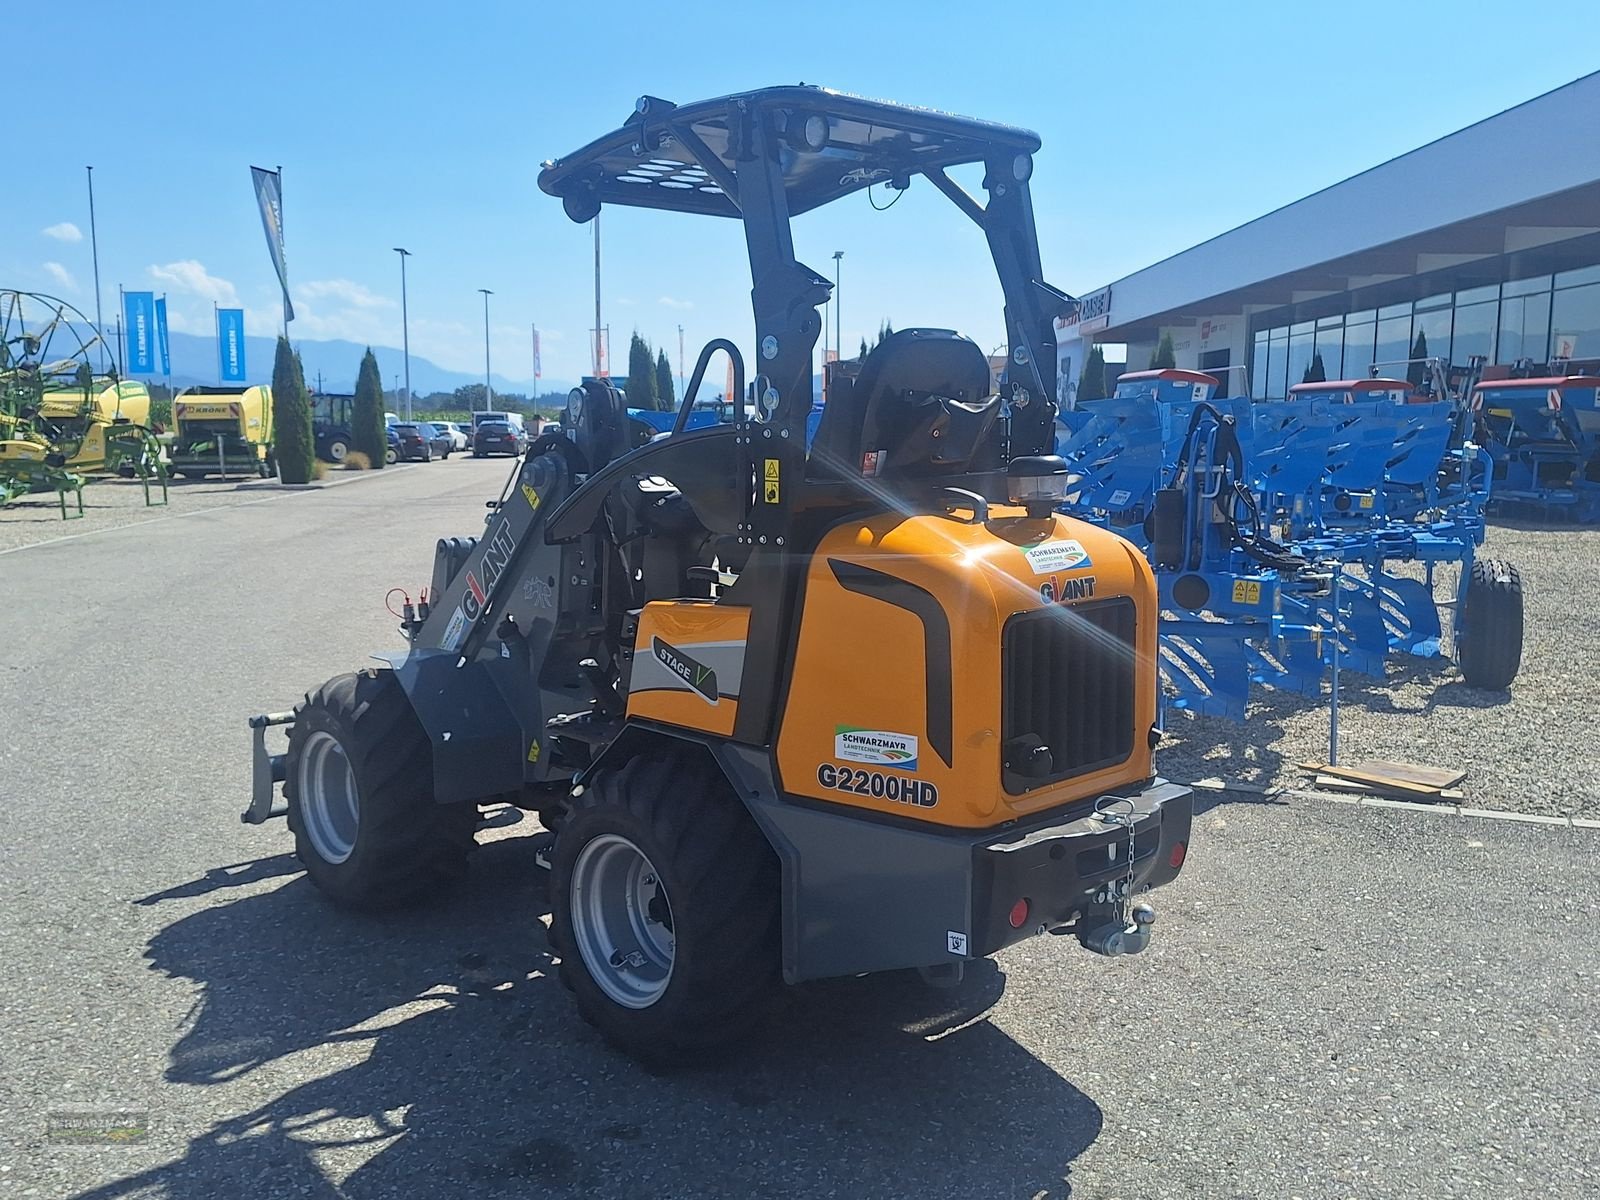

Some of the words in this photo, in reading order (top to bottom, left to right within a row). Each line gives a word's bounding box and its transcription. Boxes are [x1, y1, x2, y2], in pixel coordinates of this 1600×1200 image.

[137, 314, 146, 357] LEMKEN
[229, 329, 238, 367] LEMKEN
[1029, 545, 1078, 558] SCHWARZMAYR
[659, 648, 692, 680] STAGE
[695, 664, 713, 686] V
[842, 733, 907, 751] SCHWARZMAYR
[843, 743, 881, 754] LANDTECHNIK
[817, 762, 939, 809] G2200HD
